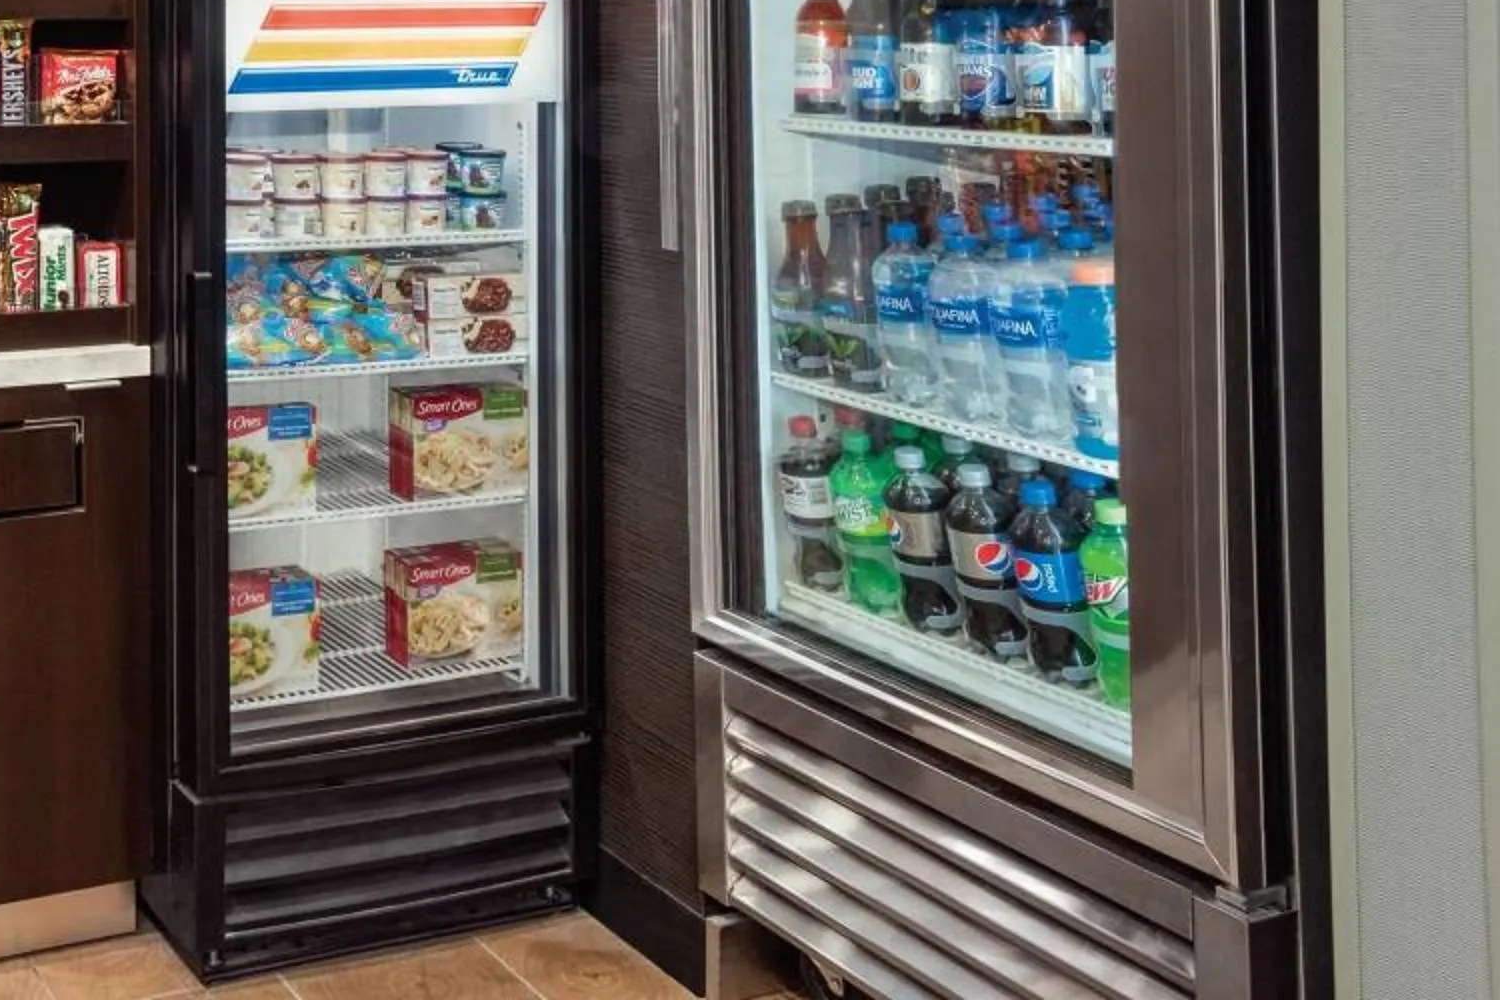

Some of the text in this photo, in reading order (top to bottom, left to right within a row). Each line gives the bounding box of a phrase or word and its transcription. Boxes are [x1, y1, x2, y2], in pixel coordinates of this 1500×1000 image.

[8, 201, 39, 301] TWIX
[417, 400, 450, 416] Smart
[451, 397, 477, 413] Ones
[411, 566, 444, 583] Smart
[444, 562, 471, 578] Ones
